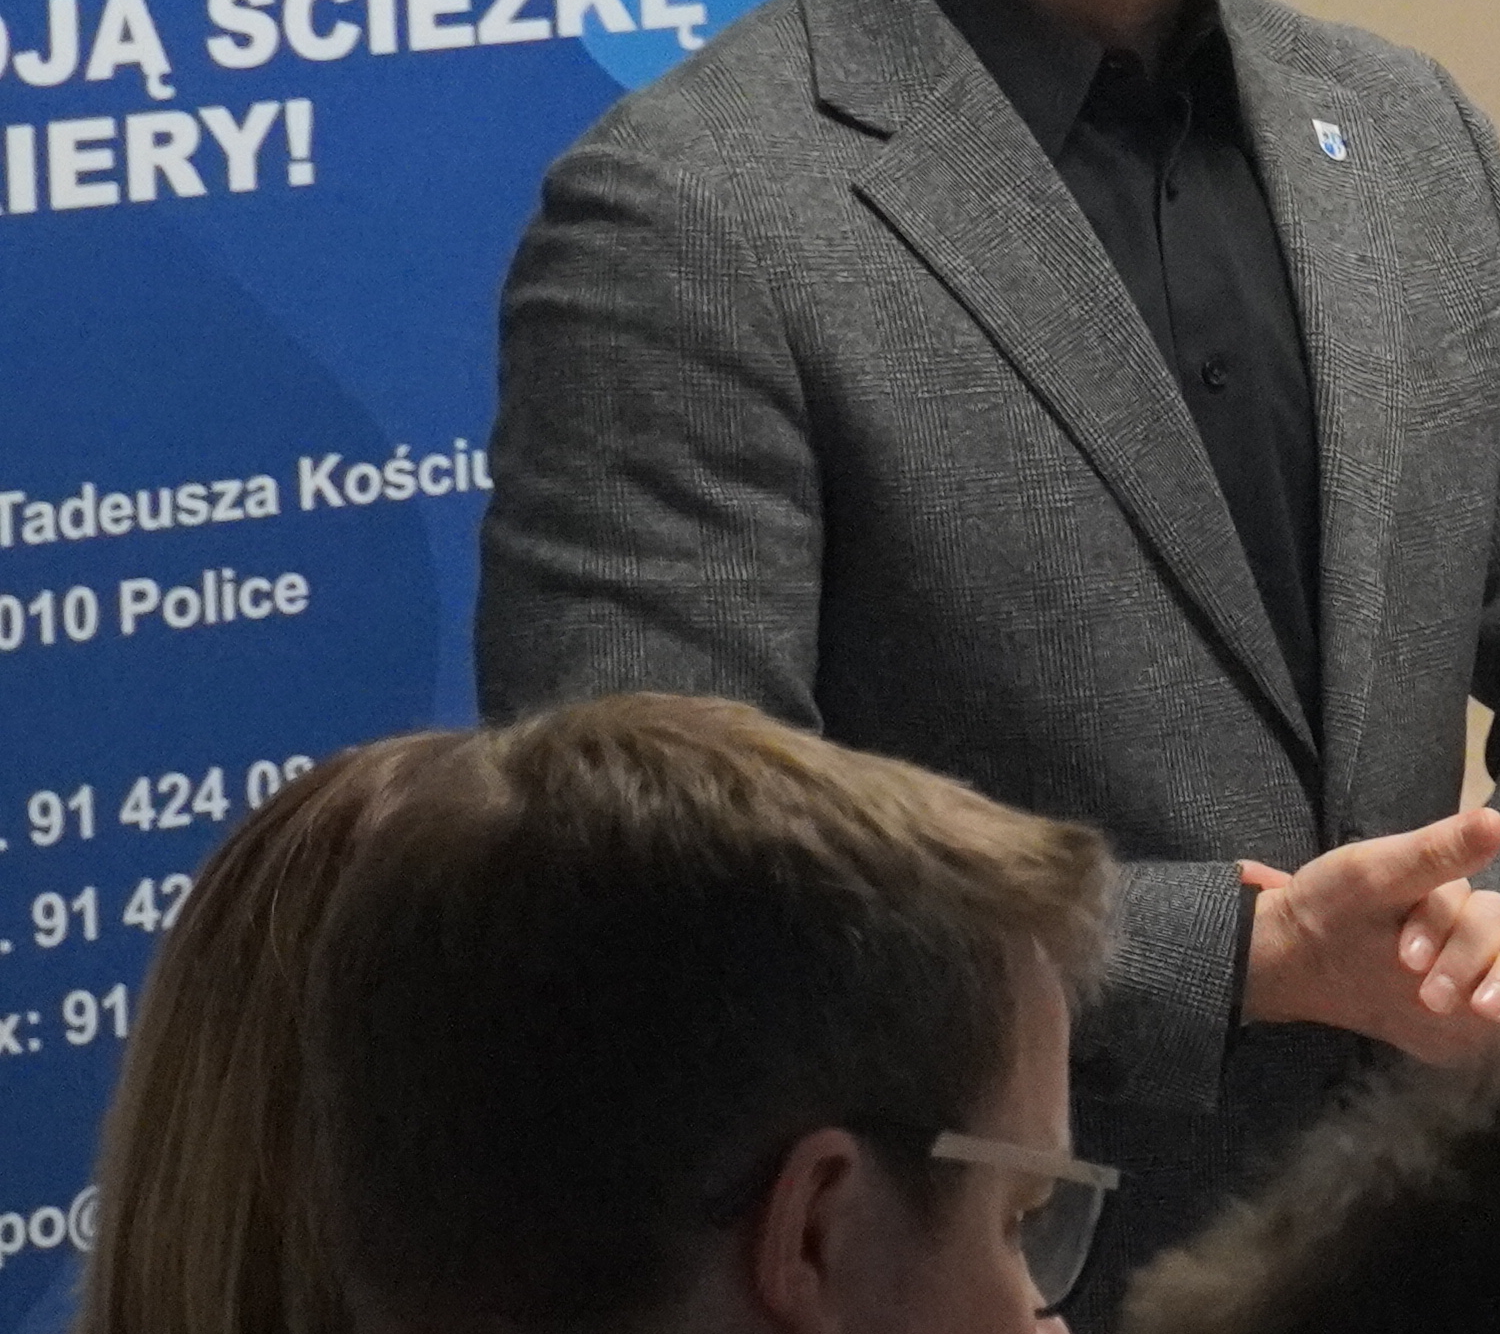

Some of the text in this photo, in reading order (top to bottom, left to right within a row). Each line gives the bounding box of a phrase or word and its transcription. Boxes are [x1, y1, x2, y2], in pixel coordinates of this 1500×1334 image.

[0, 97, 316, 215] IERY!
[0, 474, 280, 547] Tadeusza
[119, 567, 310, 635] Police
[27, 784, 94, 847] 91
[118, 766, 230, 831] 424
[31, 885, 98, 949] 91
[62, 982, 129, 1046] 91
